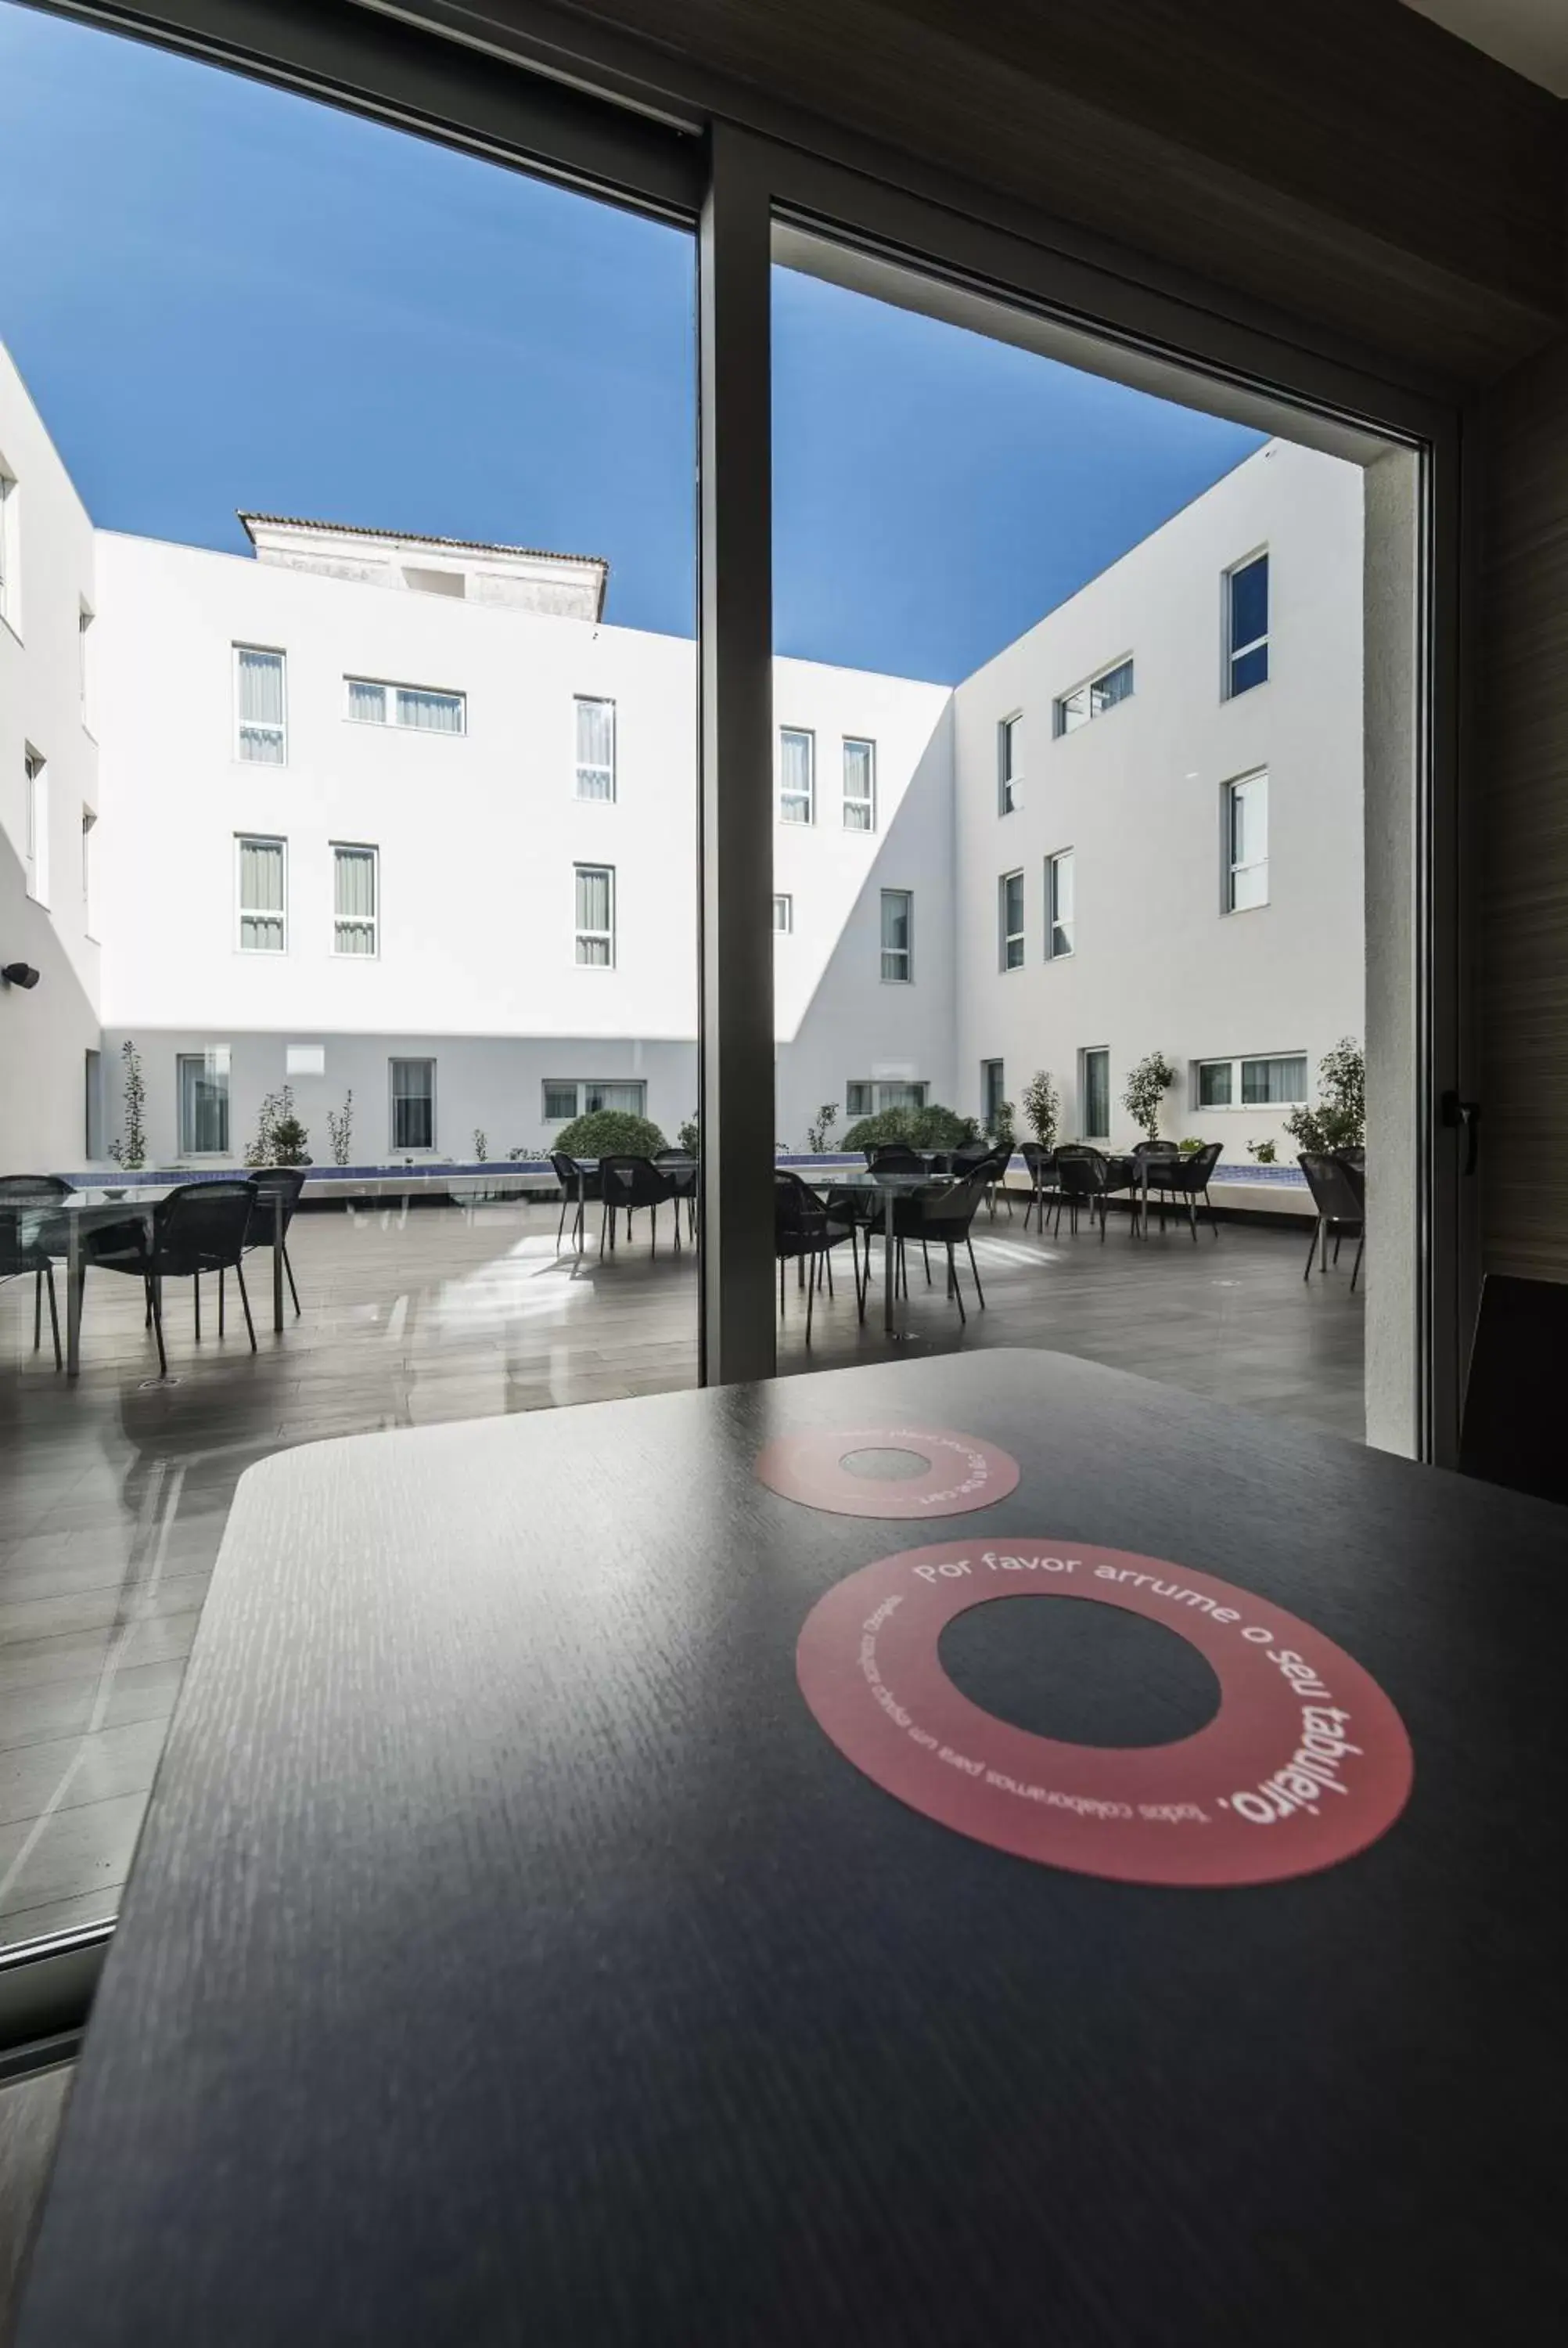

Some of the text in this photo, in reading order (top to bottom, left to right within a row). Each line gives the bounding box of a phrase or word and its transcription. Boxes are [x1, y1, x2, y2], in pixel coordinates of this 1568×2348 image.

[912, 1551, 1365, 1825] Por favor arrume o seu tabuleiro.
